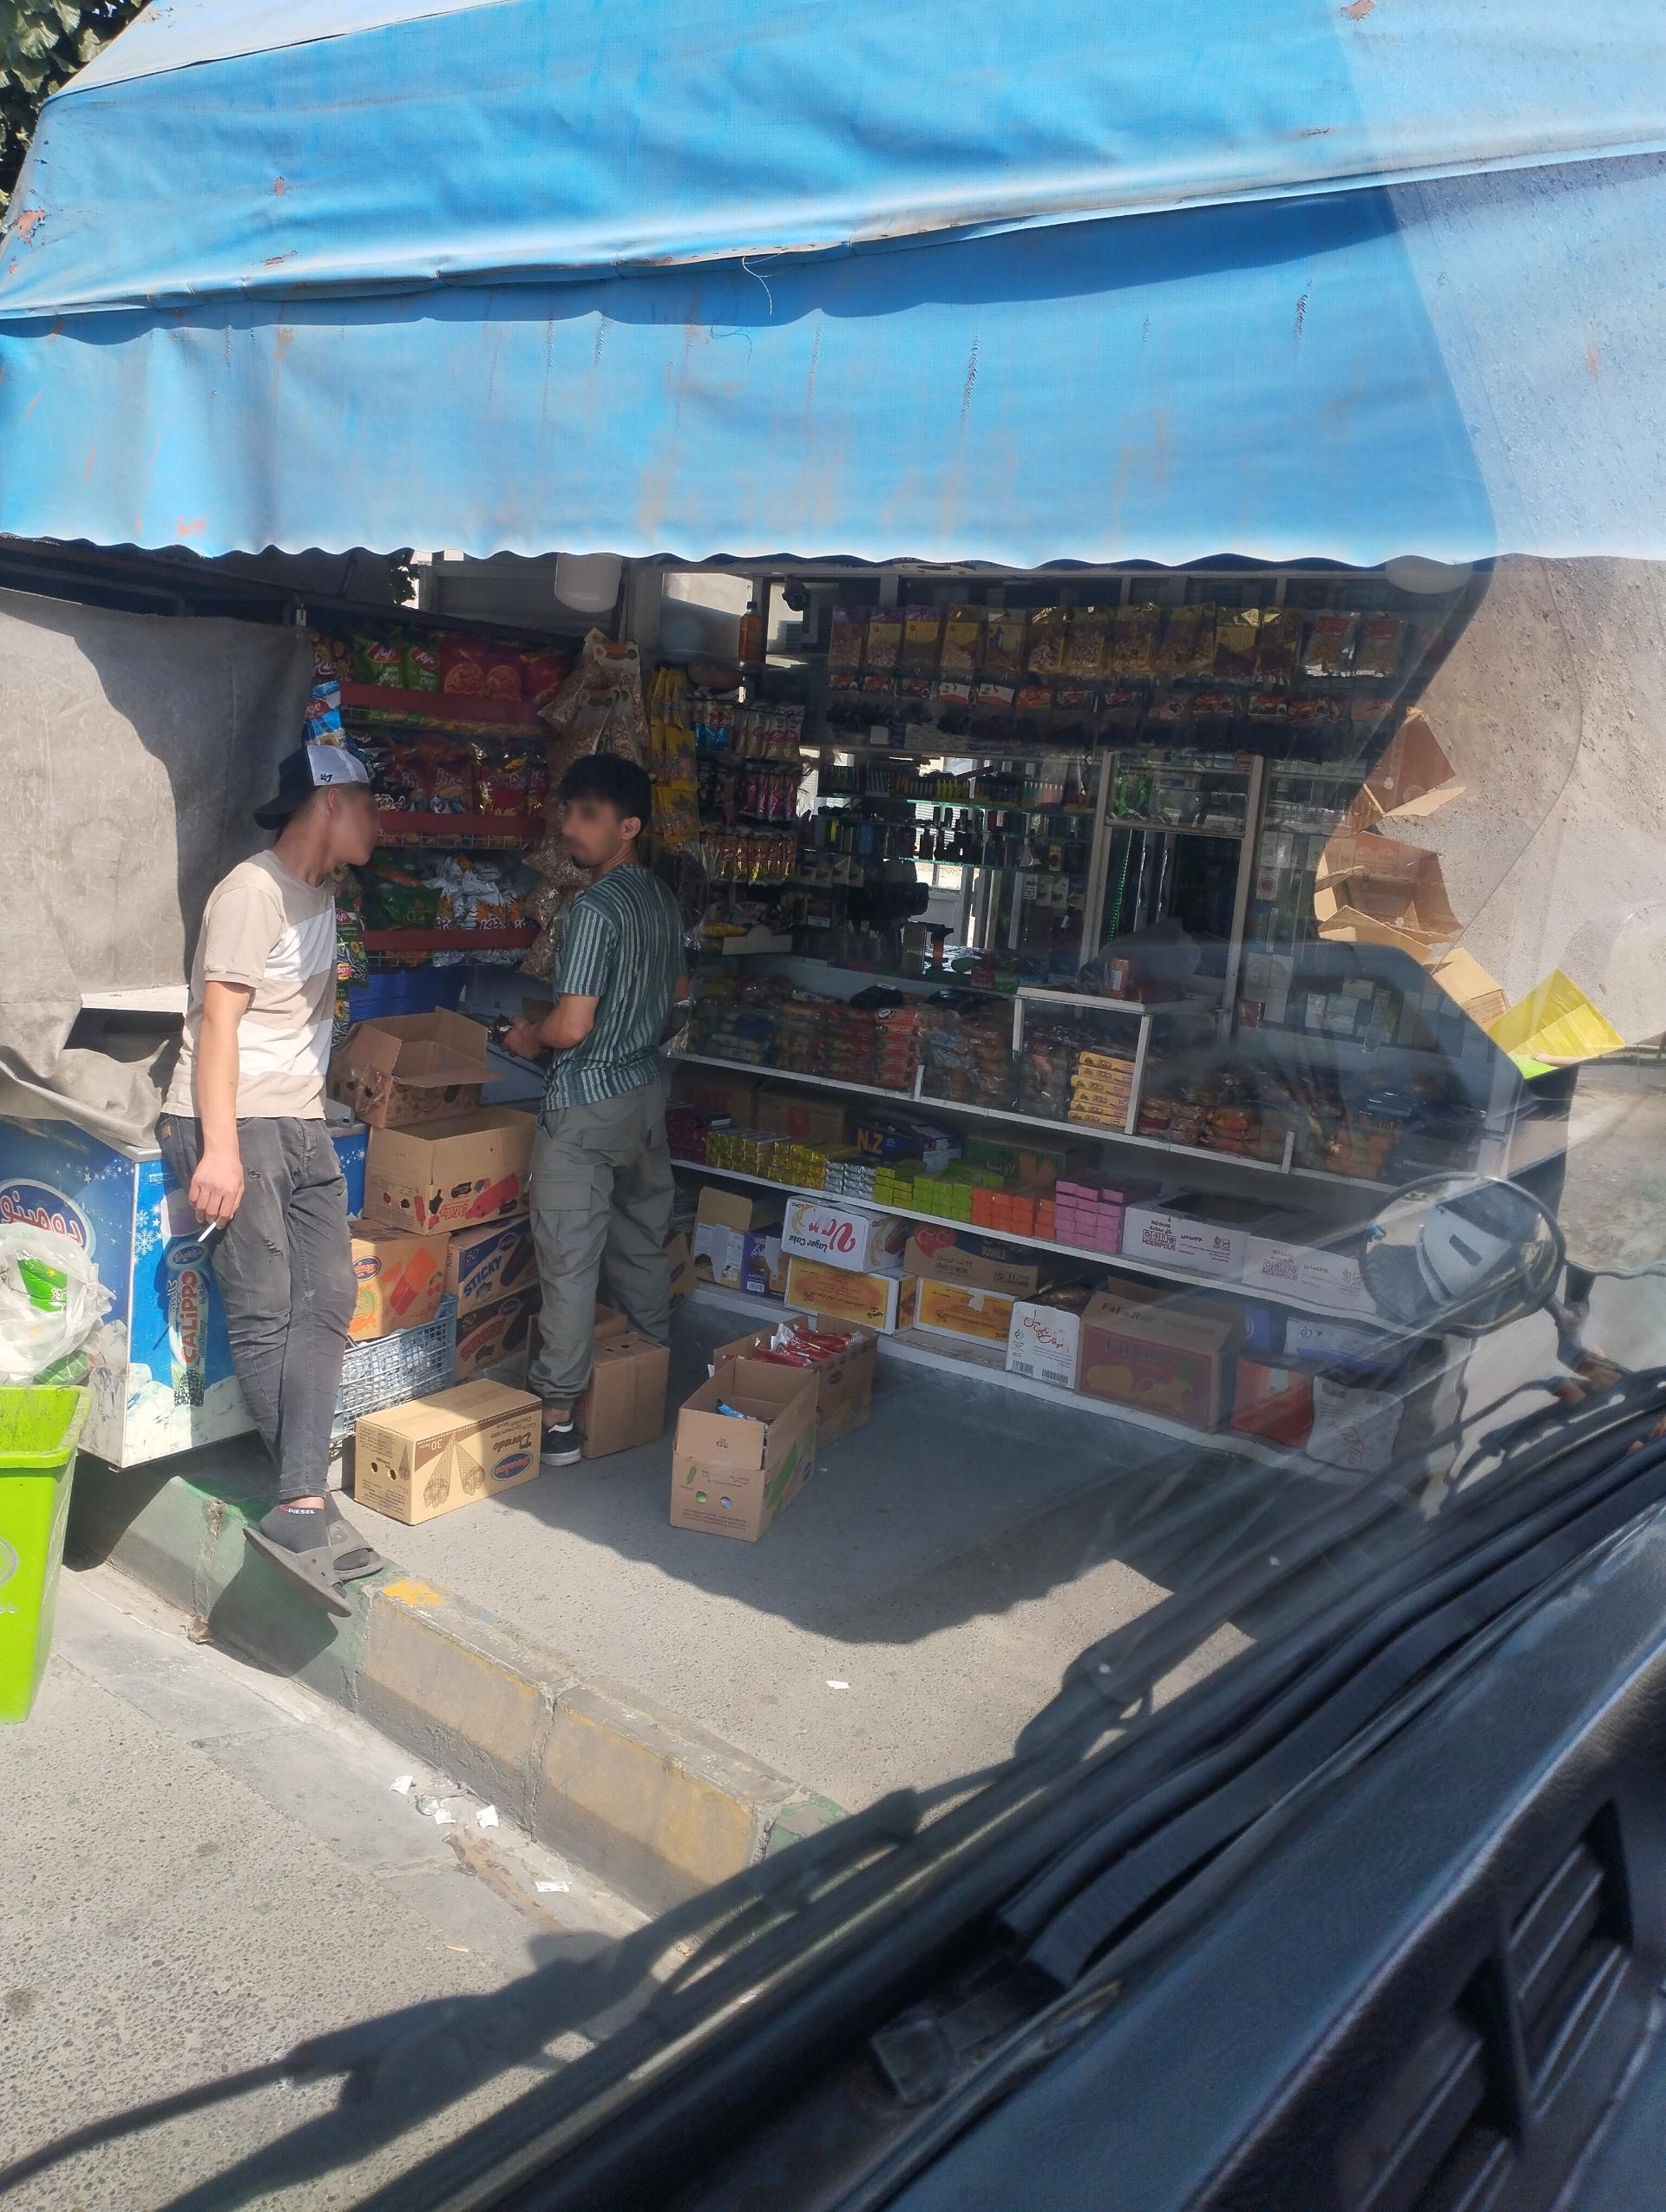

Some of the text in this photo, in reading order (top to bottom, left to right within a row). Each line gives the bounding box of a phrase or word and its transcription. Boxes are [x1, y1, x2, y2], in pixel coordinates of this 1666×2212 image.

[788, 1234, 828, 1253] Layer Cake
[463, 1257, 502, 1297] STICKY
[431, 1439, 443, 1450] 30
[493, 1432, 532, 1453] Dorado
